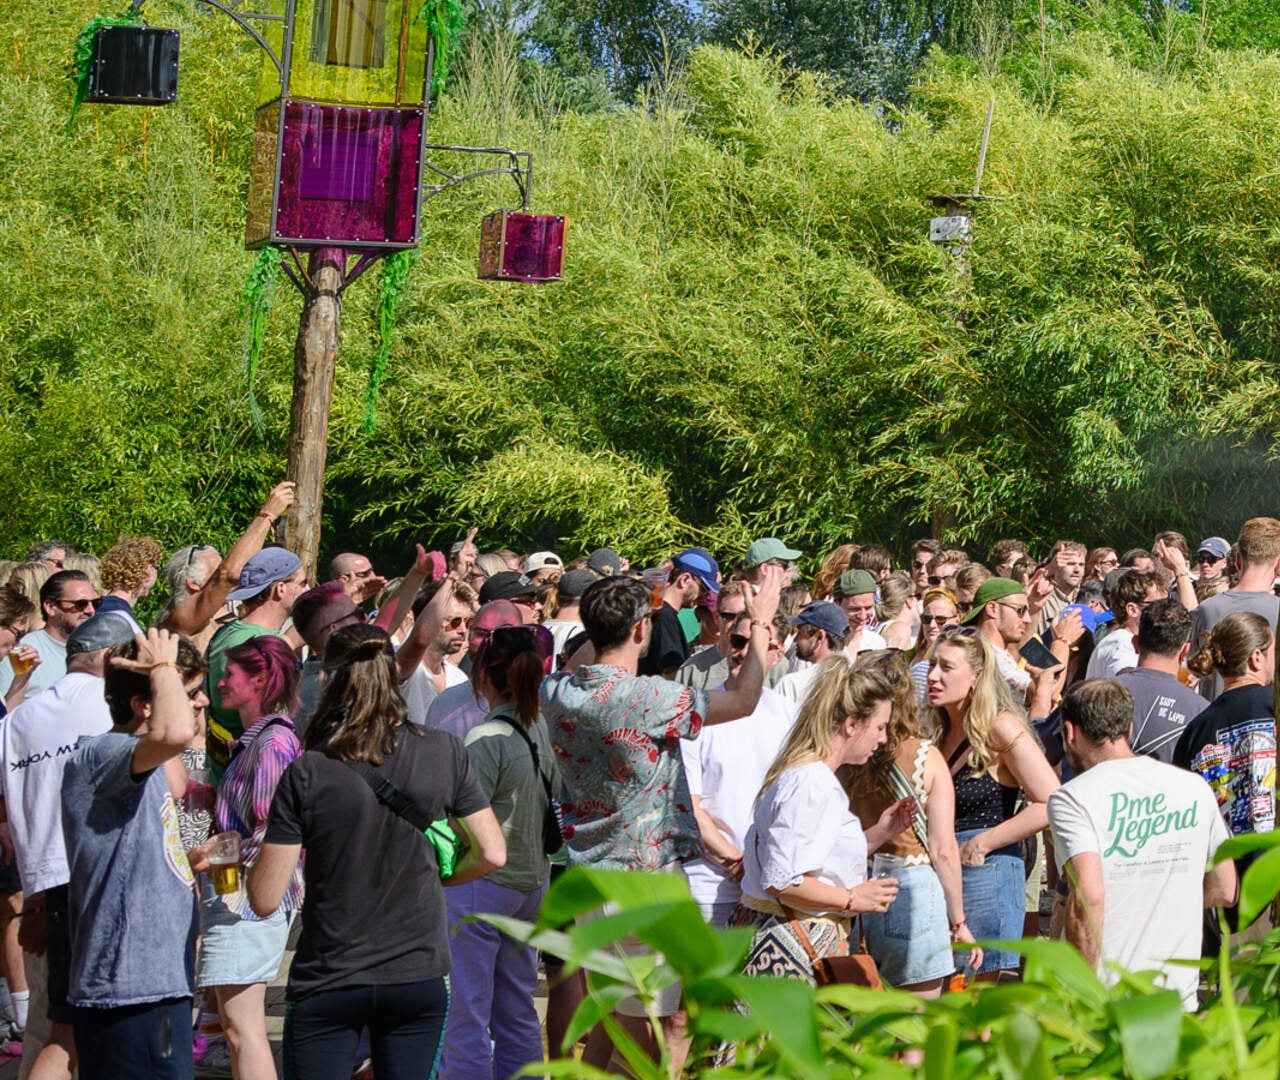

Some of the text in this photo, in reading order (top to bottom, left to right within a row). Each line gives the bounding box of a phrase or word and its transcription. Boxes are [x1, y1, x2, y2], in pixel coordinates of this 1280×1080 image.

[10, 751, 52, 772] YORK
[1103, 800, 1198, 858] Legend
[1107, 792, 1167, 832] Pme
